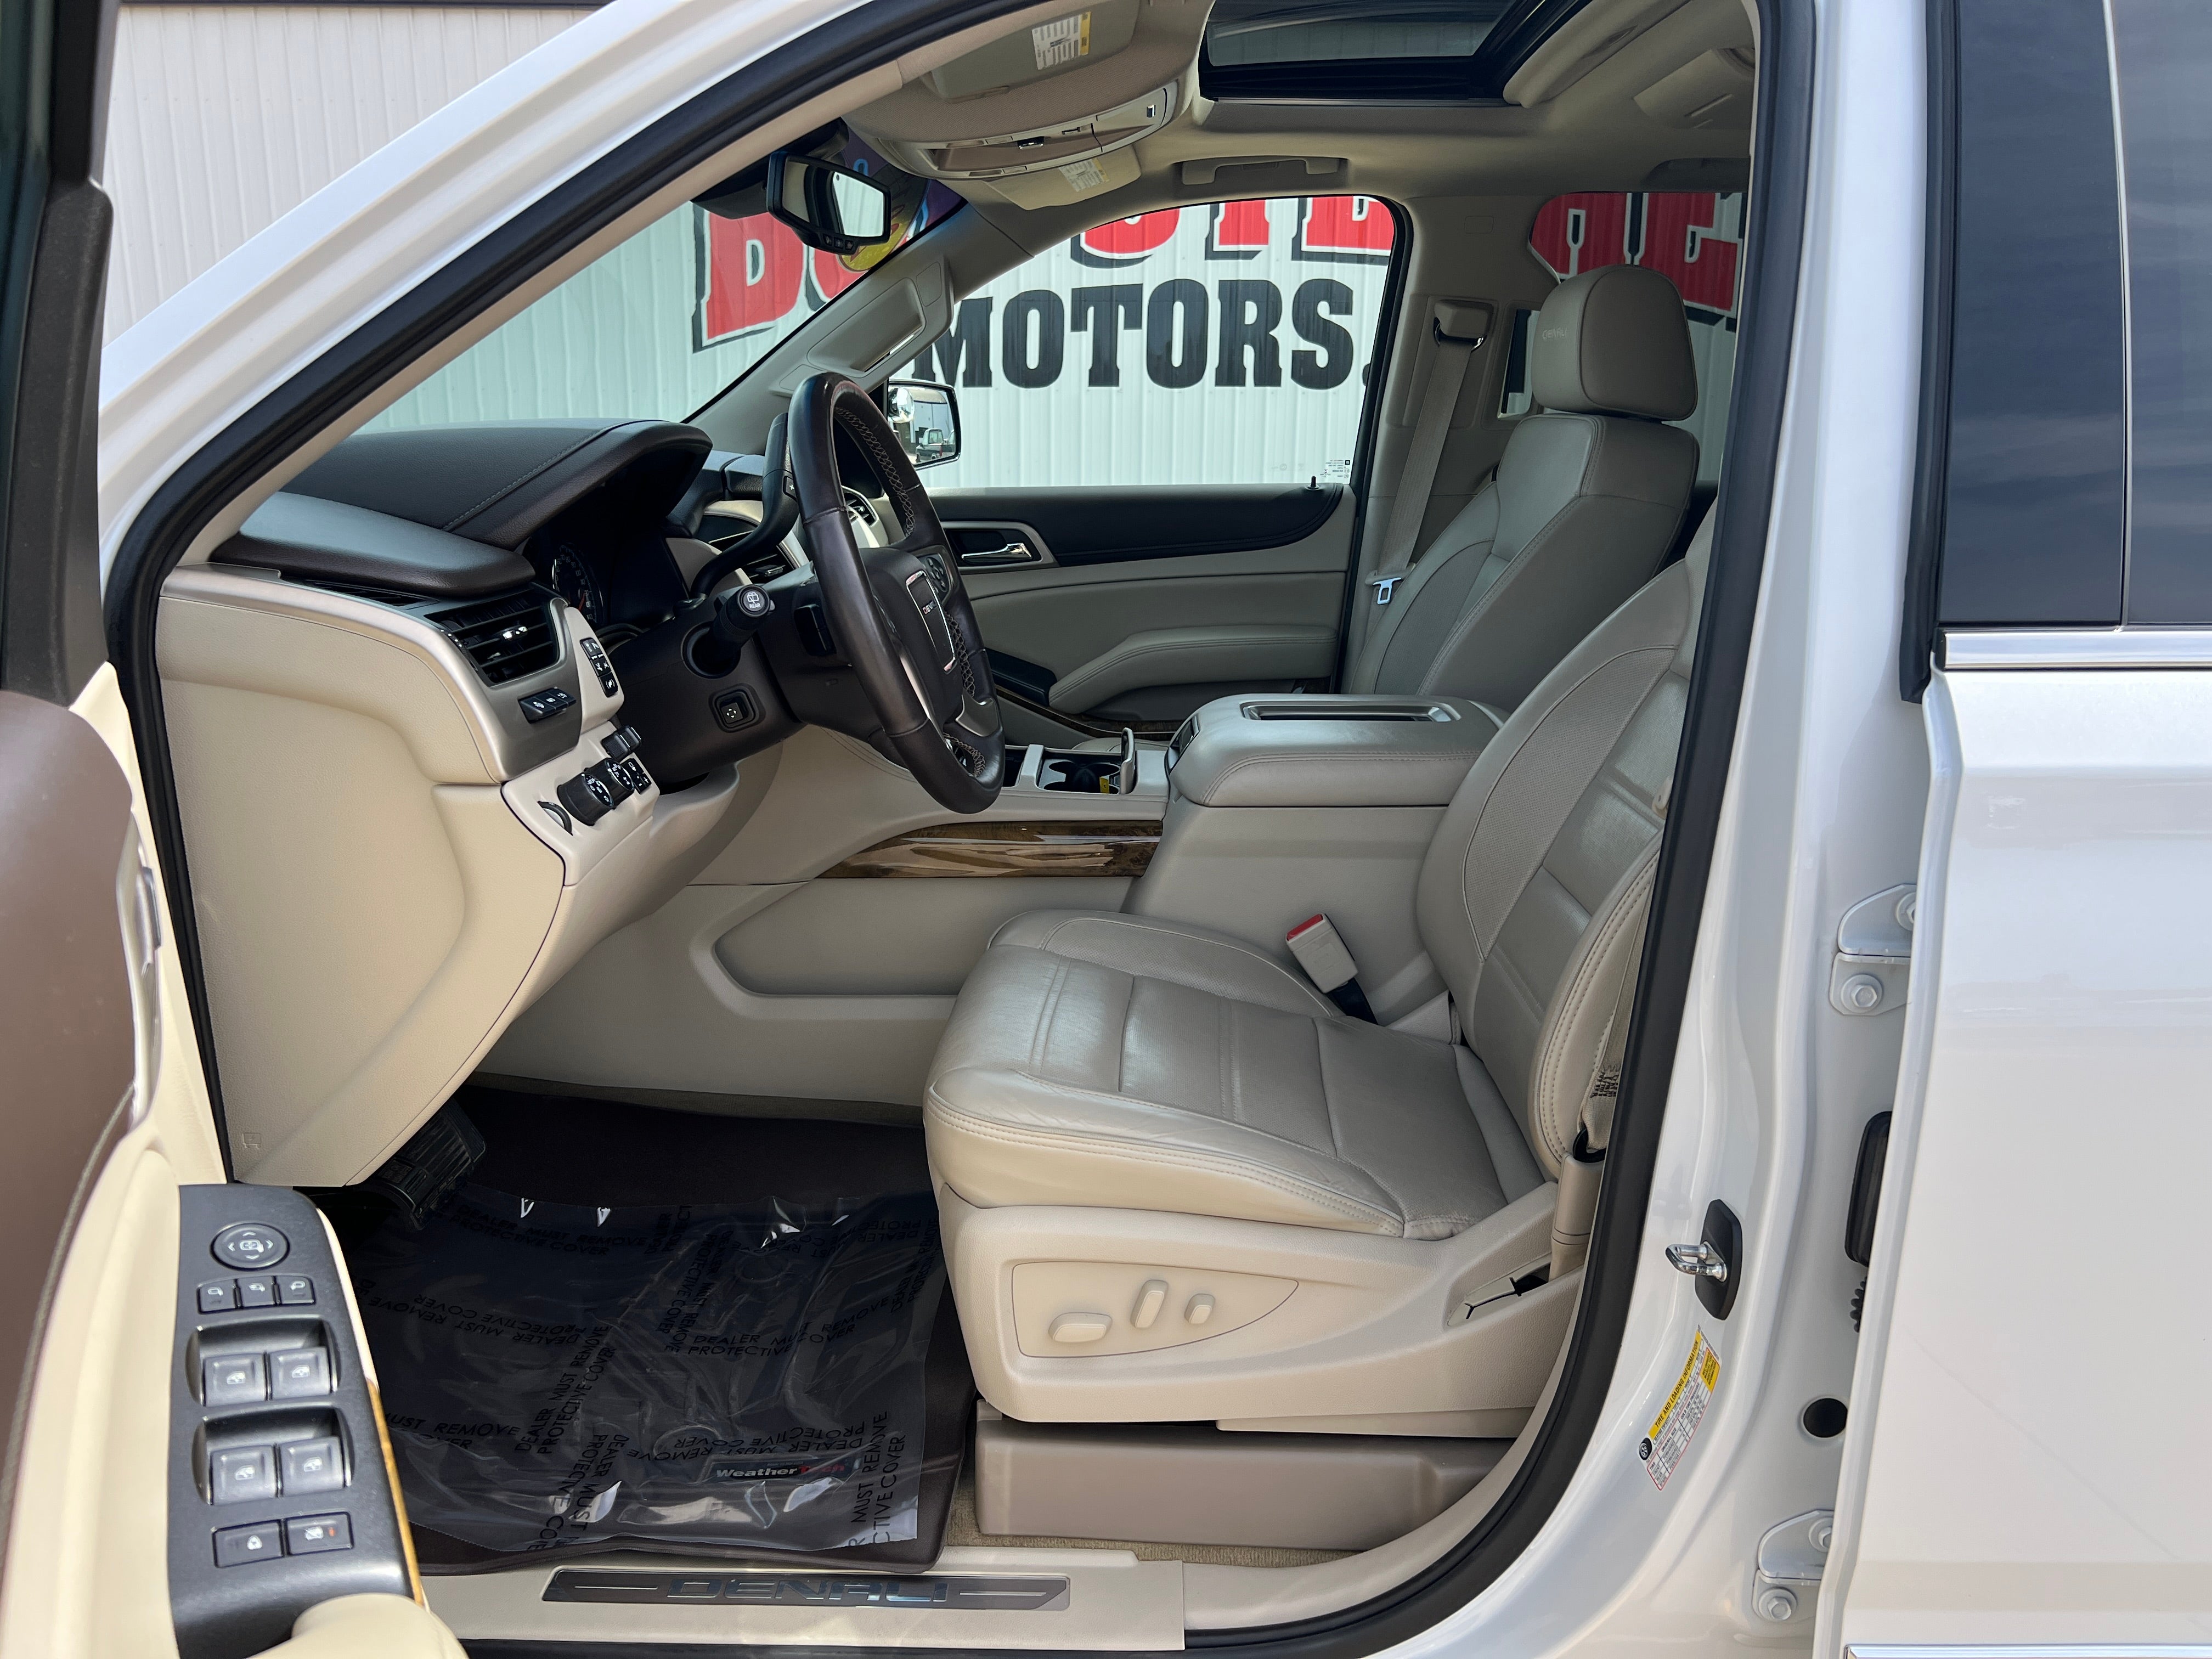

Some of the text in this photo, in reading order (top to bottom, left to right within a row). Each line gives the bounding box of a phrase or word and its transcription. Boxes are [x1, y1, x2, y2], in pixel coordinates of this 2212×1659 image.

[549, 1241, 610, 1256] COVER
[368, 1296, 580, 1345] DEALER MUST REMOVE
[414, 1294, 477, 1319] COVER
[656, 1299, 686, 1334] COVER
[693, 1334, 760, 1345] DEALER
[821, 1296, 890, 1333] REMOVE
[687, 1323, 856, 1357] PROTECTIVE COVER
[514, 1325, 610, 1452] DEALER MUST REMOVE
[537, 1347, 617, 1454] PROTECTIVE COVER
[1655, 1414, 1664, 1428] TIRE
[1662, 1402, 1671, 1415] AND
[1670, 1378, 1684, 1403] LOADING
[1682, 1339, 1699, 1380] INFORMATION
[433, 1422, 521, 1436] REMOVE
[674, 1420, 865, 1449] PROTECTIVE COVER
[783, 1437, 862, 1453] DEALER
[862, 1411, 887, 1473] REMOVE
[553, 1434, 608, 1508] PROTECTIVE
[627, 1447, 712, 1462] REMOVE
[881, 1435, 906, 1488] COVER
[571, 1434, 630, 1531] DEALER MUST
[851, 1483, 874, 1523] MUST
[667, 1578, 949, 1603] DENALI
